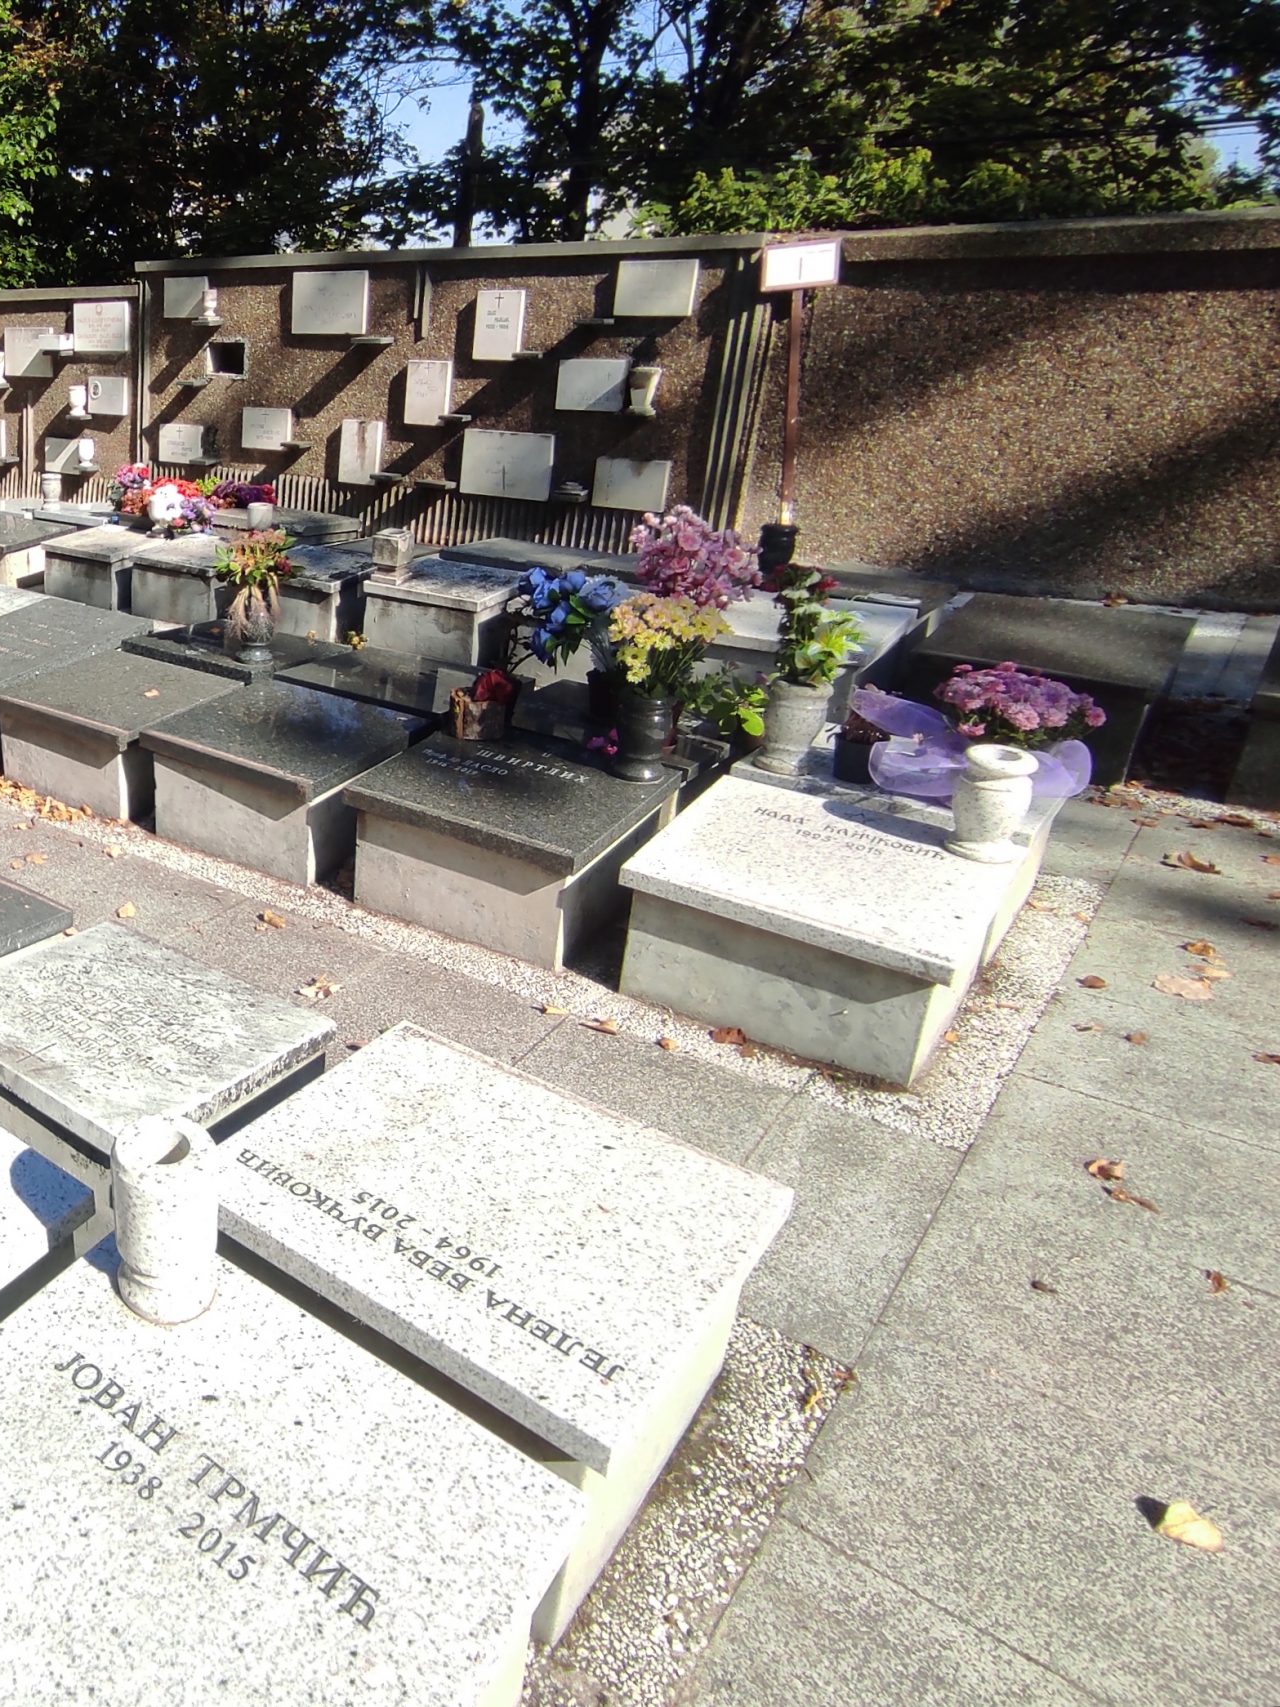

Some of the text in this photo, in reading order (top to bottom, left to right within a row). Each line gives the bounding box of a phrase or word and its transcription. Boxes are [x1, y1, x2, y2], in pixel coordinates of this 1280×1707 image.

[476, 749, 590, 784] ШВИРТЛИХ
[753, 806, 804, 826] НАДА
[356, 1190, 417, 1230] 2015
[235, 1148, 626, 1384] ЈЕЛЕНА БЕБА ВУЧКОВИЋ
[435, 1235, 503, 1279] 1964
[54, 1351, 382, 1631] ЈОВАН ТРМЧИЋ
[94, 1441, 163, 1502] 1938
[178, 1515, 258, 1582] 2015
